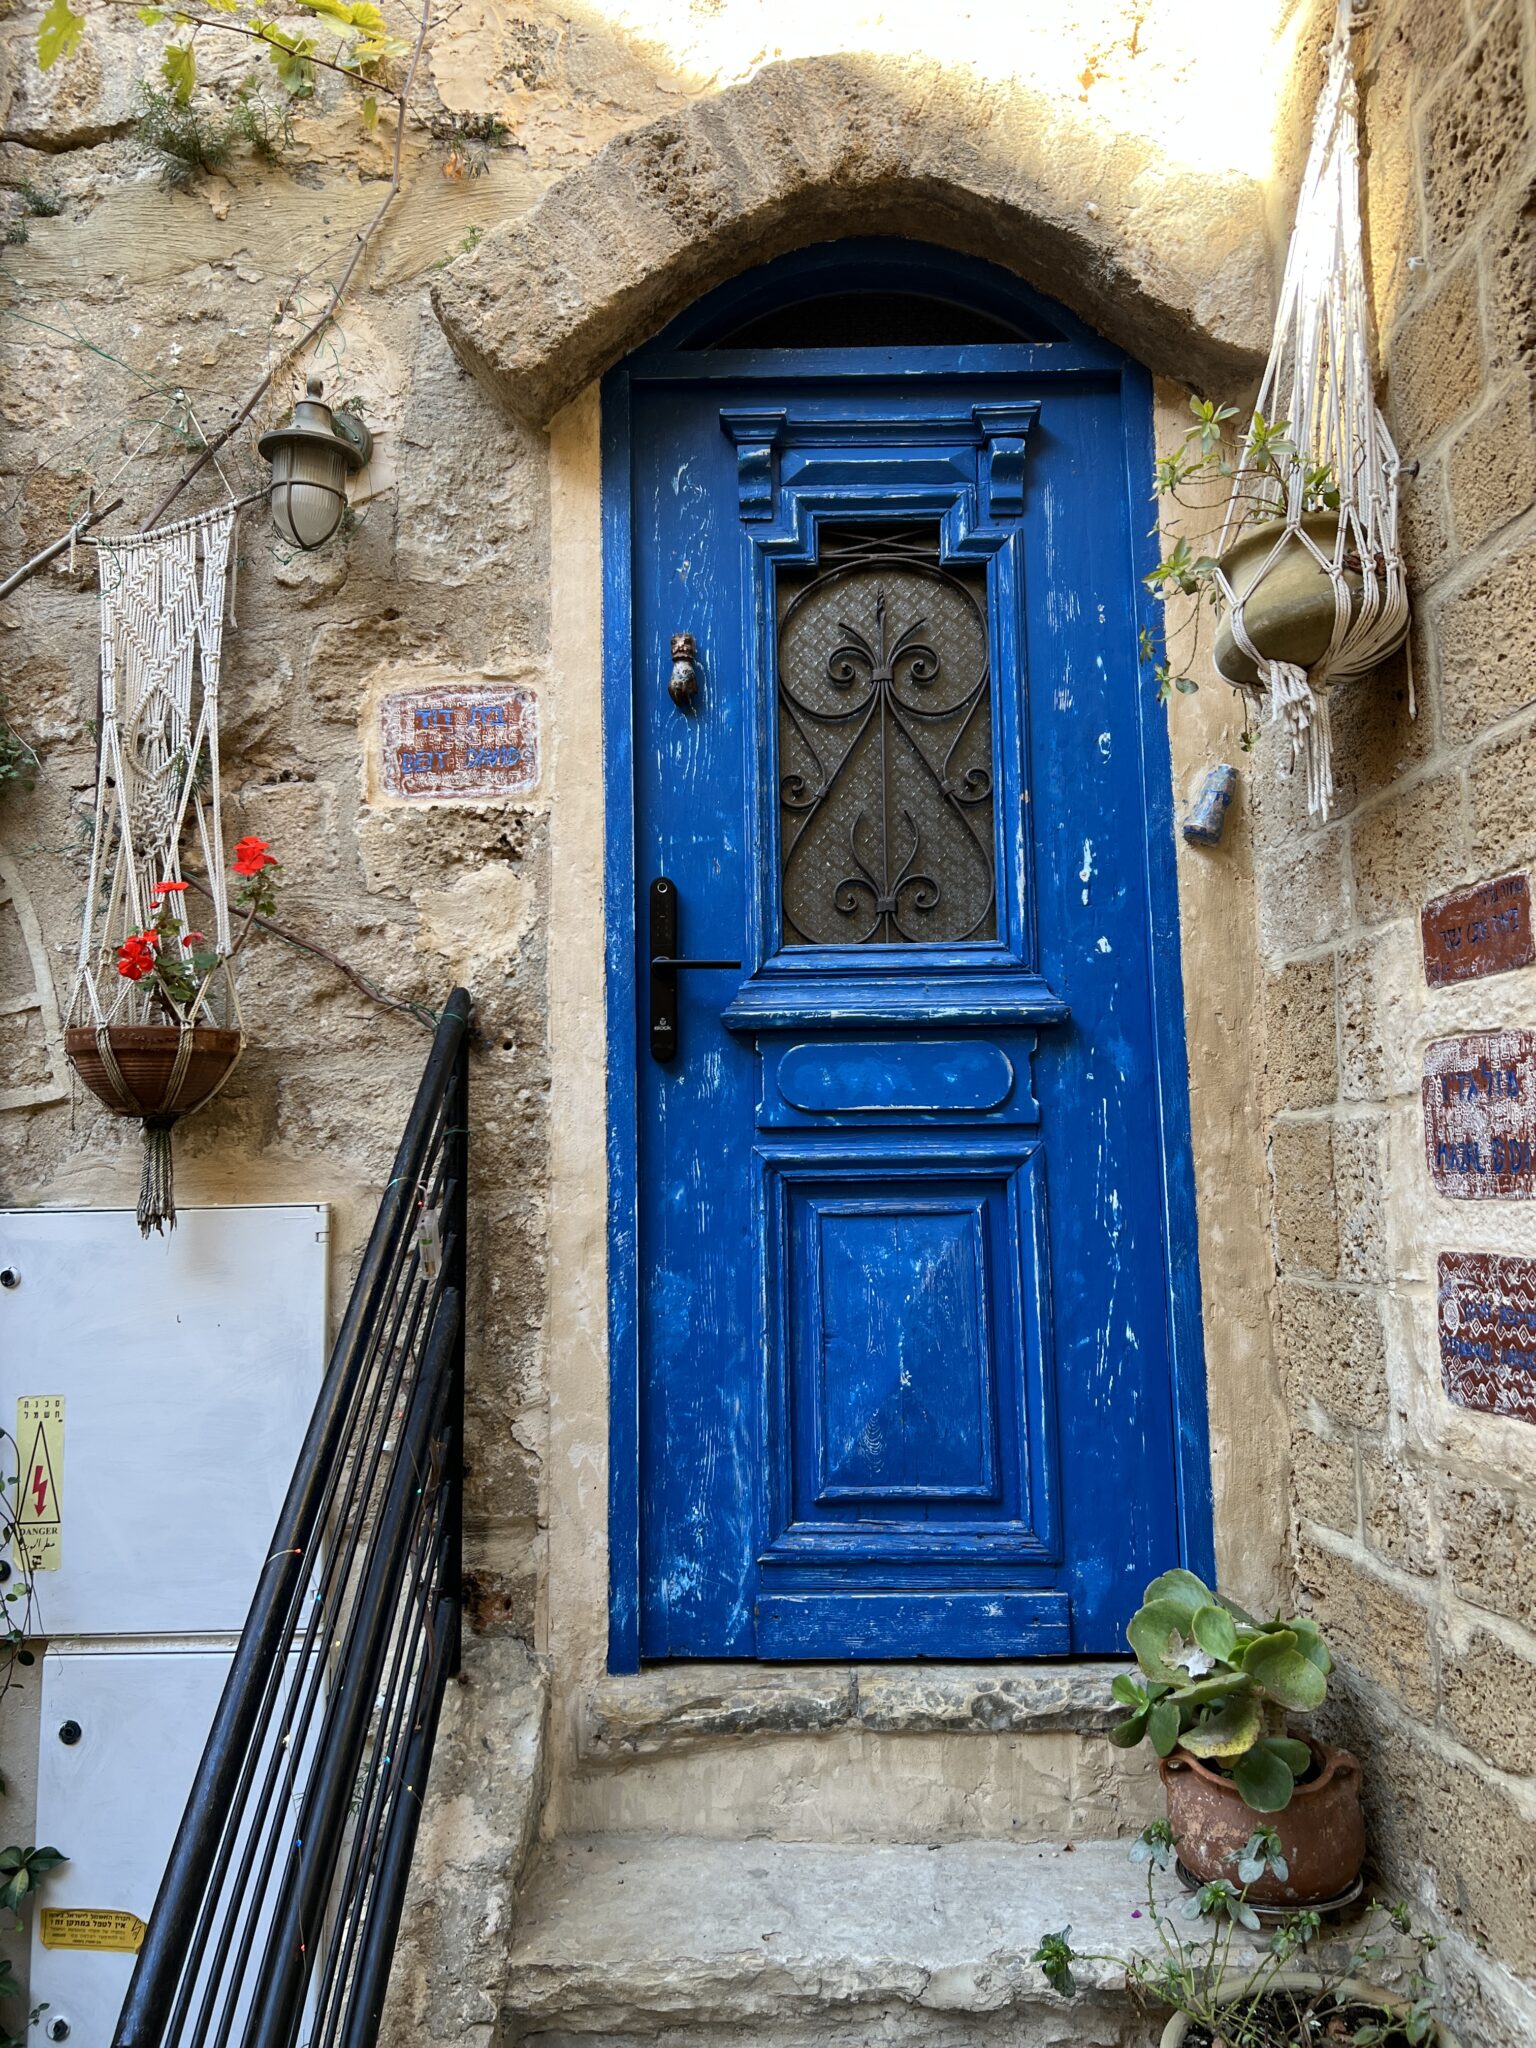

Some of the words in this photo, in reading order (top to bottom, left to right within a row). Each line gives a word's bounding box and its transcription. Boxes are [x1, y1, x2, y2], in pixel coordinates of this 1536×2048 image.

[401, 751, 449, 774] BEIT
[466, 746, 521, 768] DAVID
[19, 1527, 58, 1535] DANGER
[66, 1919, 90, 1927] במתקן
[92, 1920, 112, 1928] לטפל
